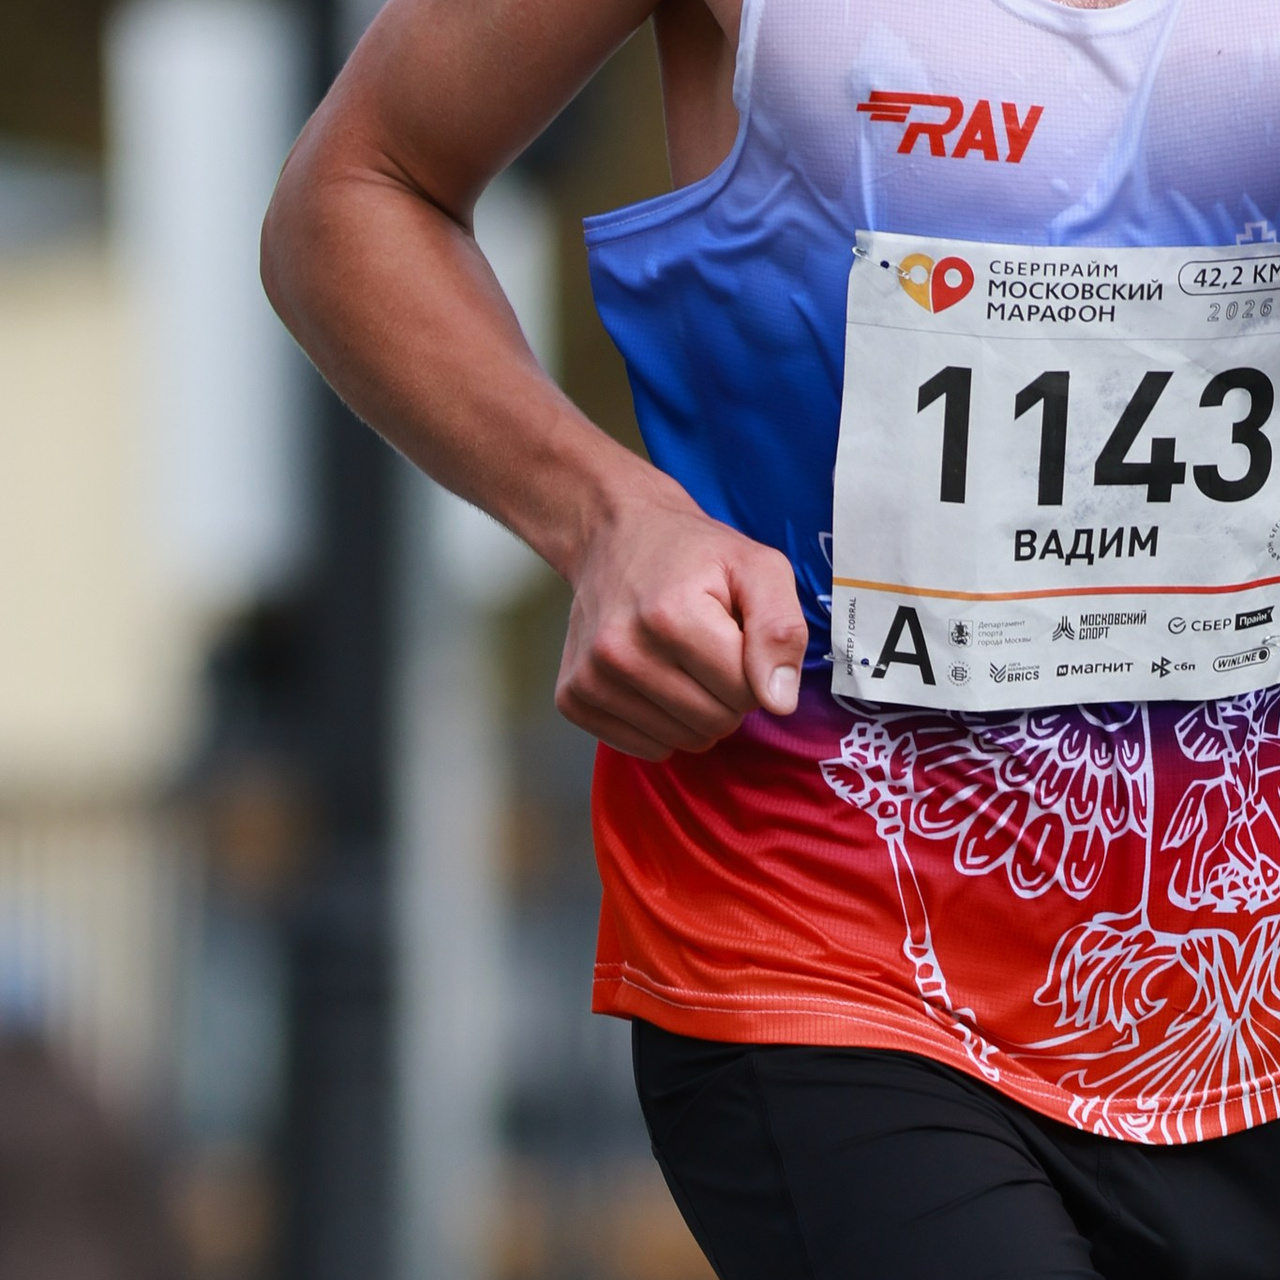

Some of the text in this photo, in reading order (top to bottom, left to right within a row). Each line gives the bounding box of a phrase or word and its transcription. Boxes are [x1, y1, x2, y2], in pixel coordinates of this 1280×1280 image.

[857, 91, 1044, 164] RAY
[989, 260, 1119, 278] СБЕРПРАЙМ
[1193, 267, 1243, 290] 42,2
[988, 279, 1164, 302] МОСКОВСКИЙ
[986, 302, 1116, 323] МАРАФОН
[1207, 298, 1274, 322] 2026
[916, 365, 1275, 506] 1143
[1013, 525, 1159, 566] ВАДИМ
[848, 597, 857, 631] CORRAL
[1079, 609, 1147, 627] МОСКОВСКИЙ
[1191, 618, 1232, 631] СБЕР
[978, 621, 1025, 629] Департамент
[1079, 626, 1111, 640] СПОРТ
[1217, 652, 1258, 669] WINLINE
[1007, 670, 1040, 683] BRICS
